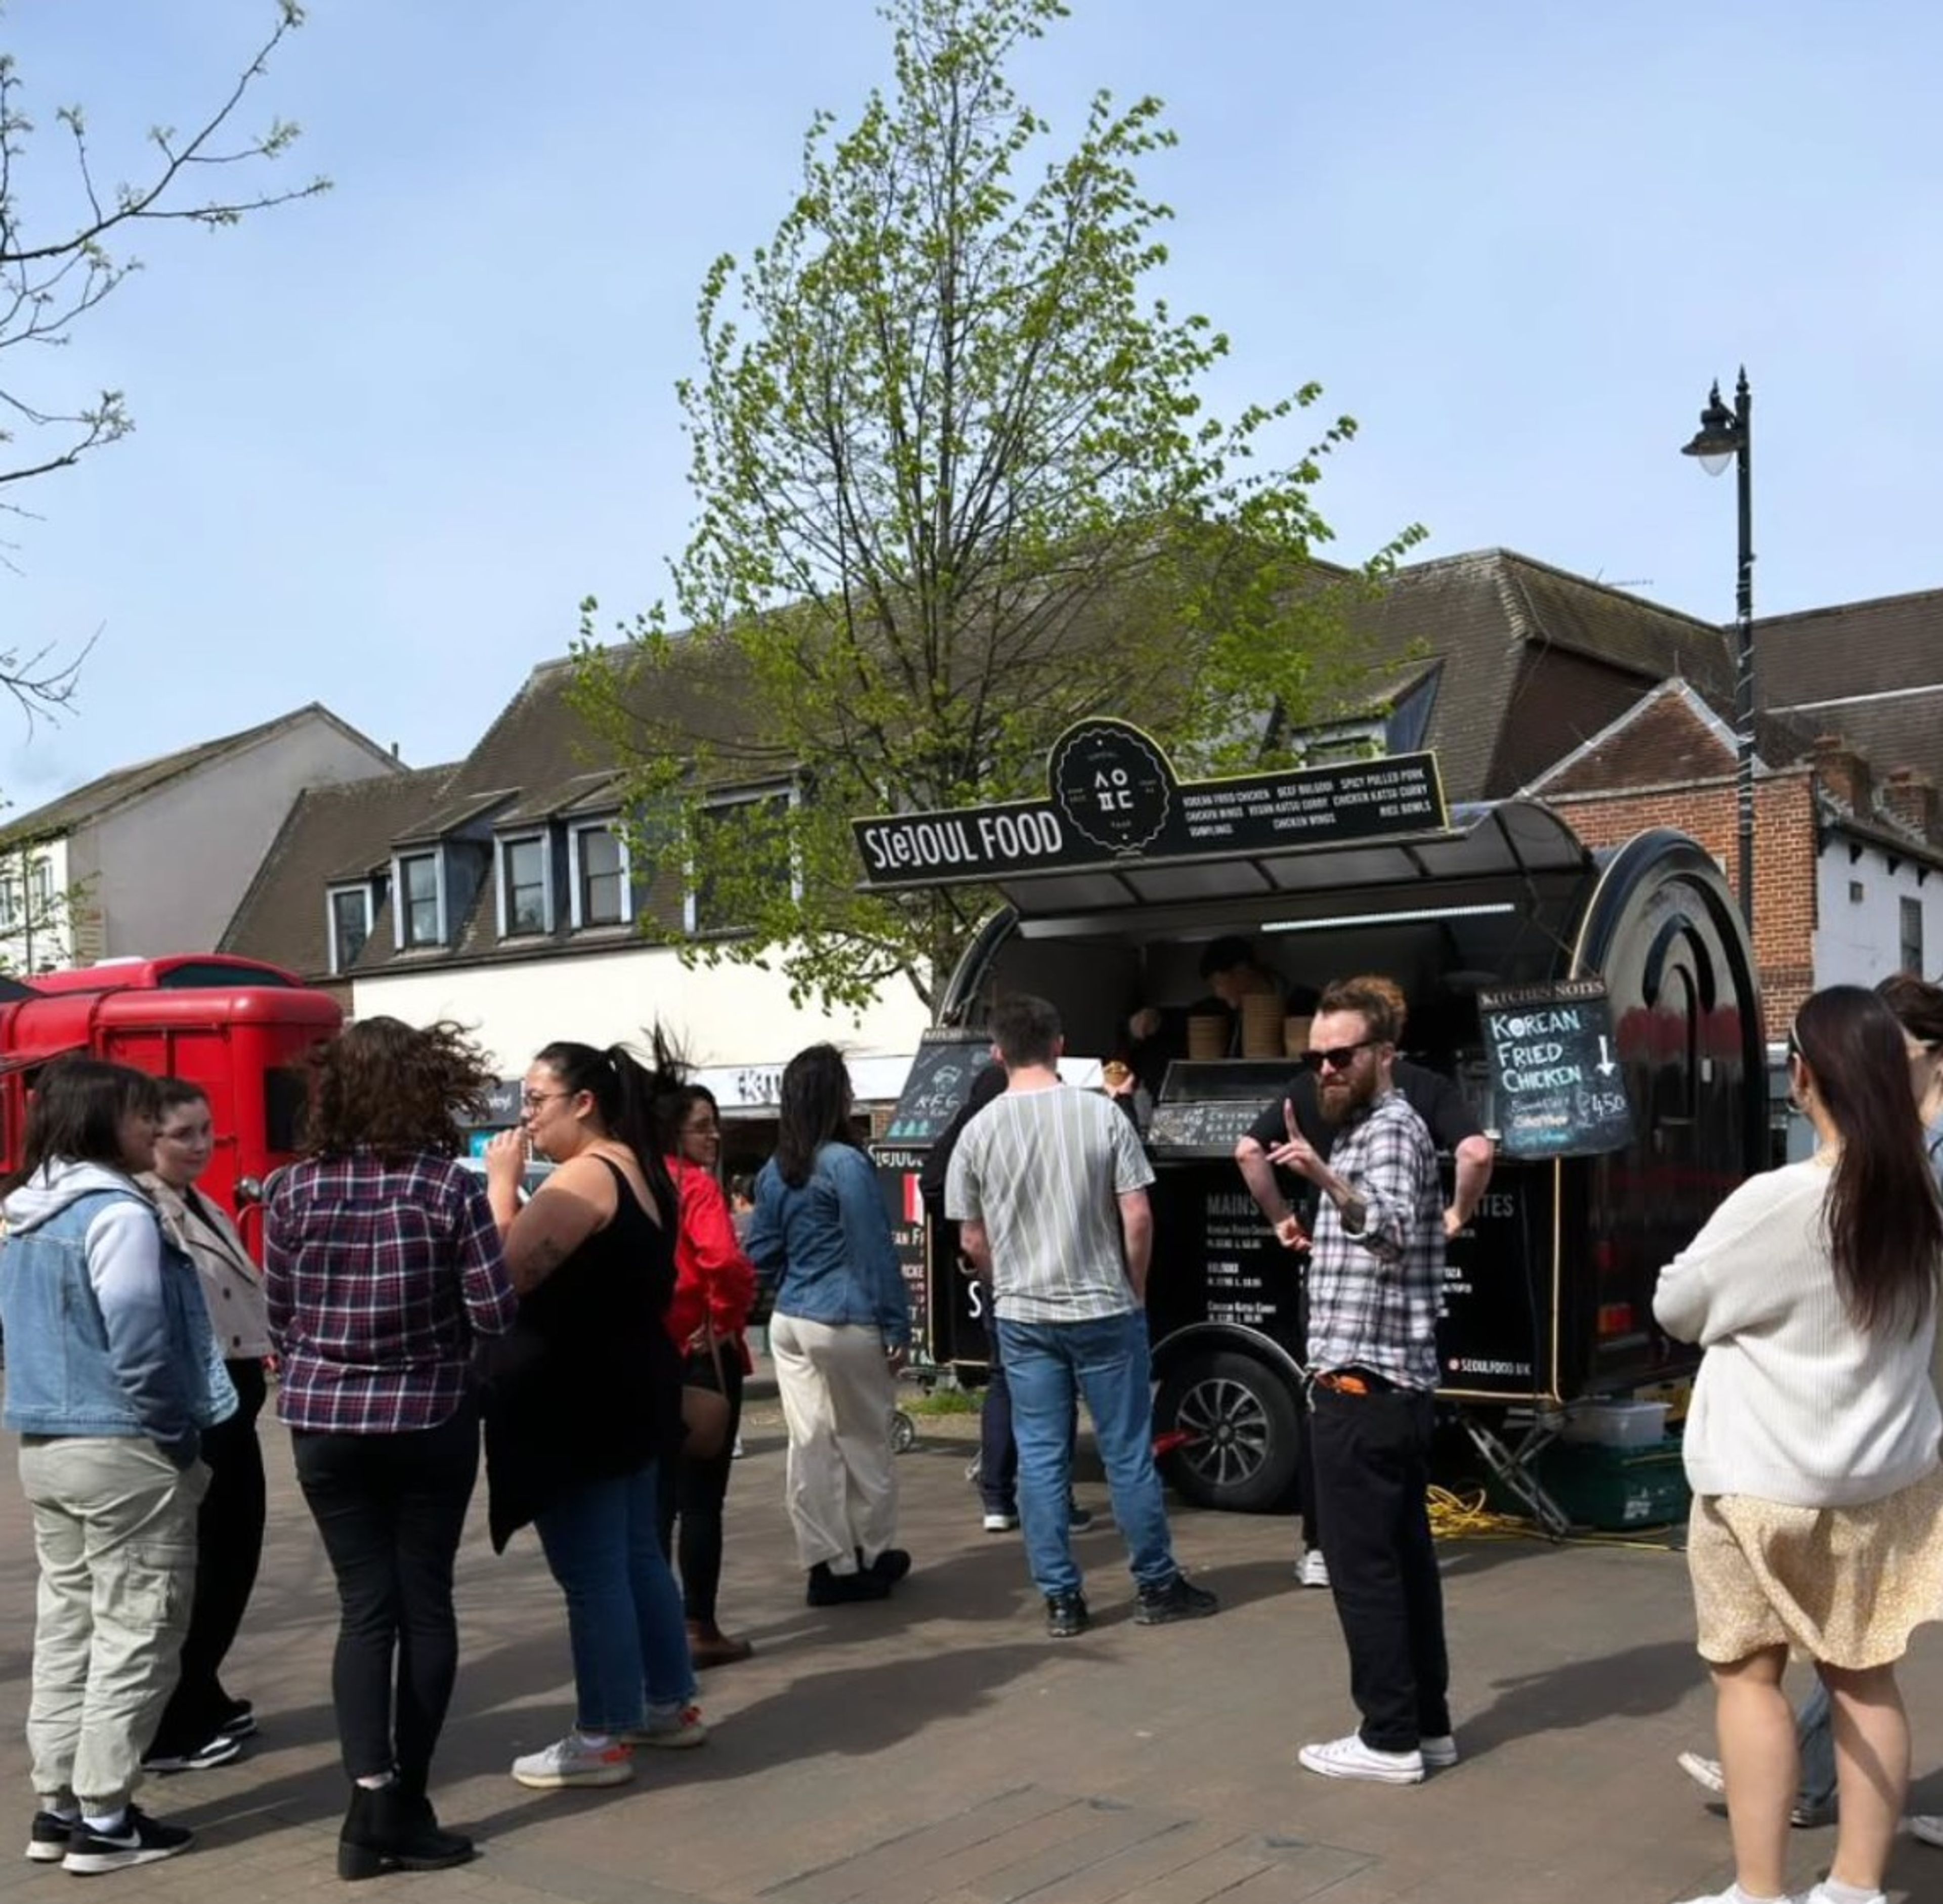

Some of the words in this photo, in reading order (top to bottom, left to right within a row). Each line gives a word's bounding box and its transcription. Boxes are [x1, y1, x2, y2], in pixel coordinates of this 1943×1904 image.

[979, 812, 1062, 858] FOOD
[1491, 1010, 1581, 1039] KOREAN
[1497, 1042, 1562, 1067] FRIED
[1502, 1066, 1581, 1092] CHICKEN
[1206, 1193, 1259, 1216] MAINS
